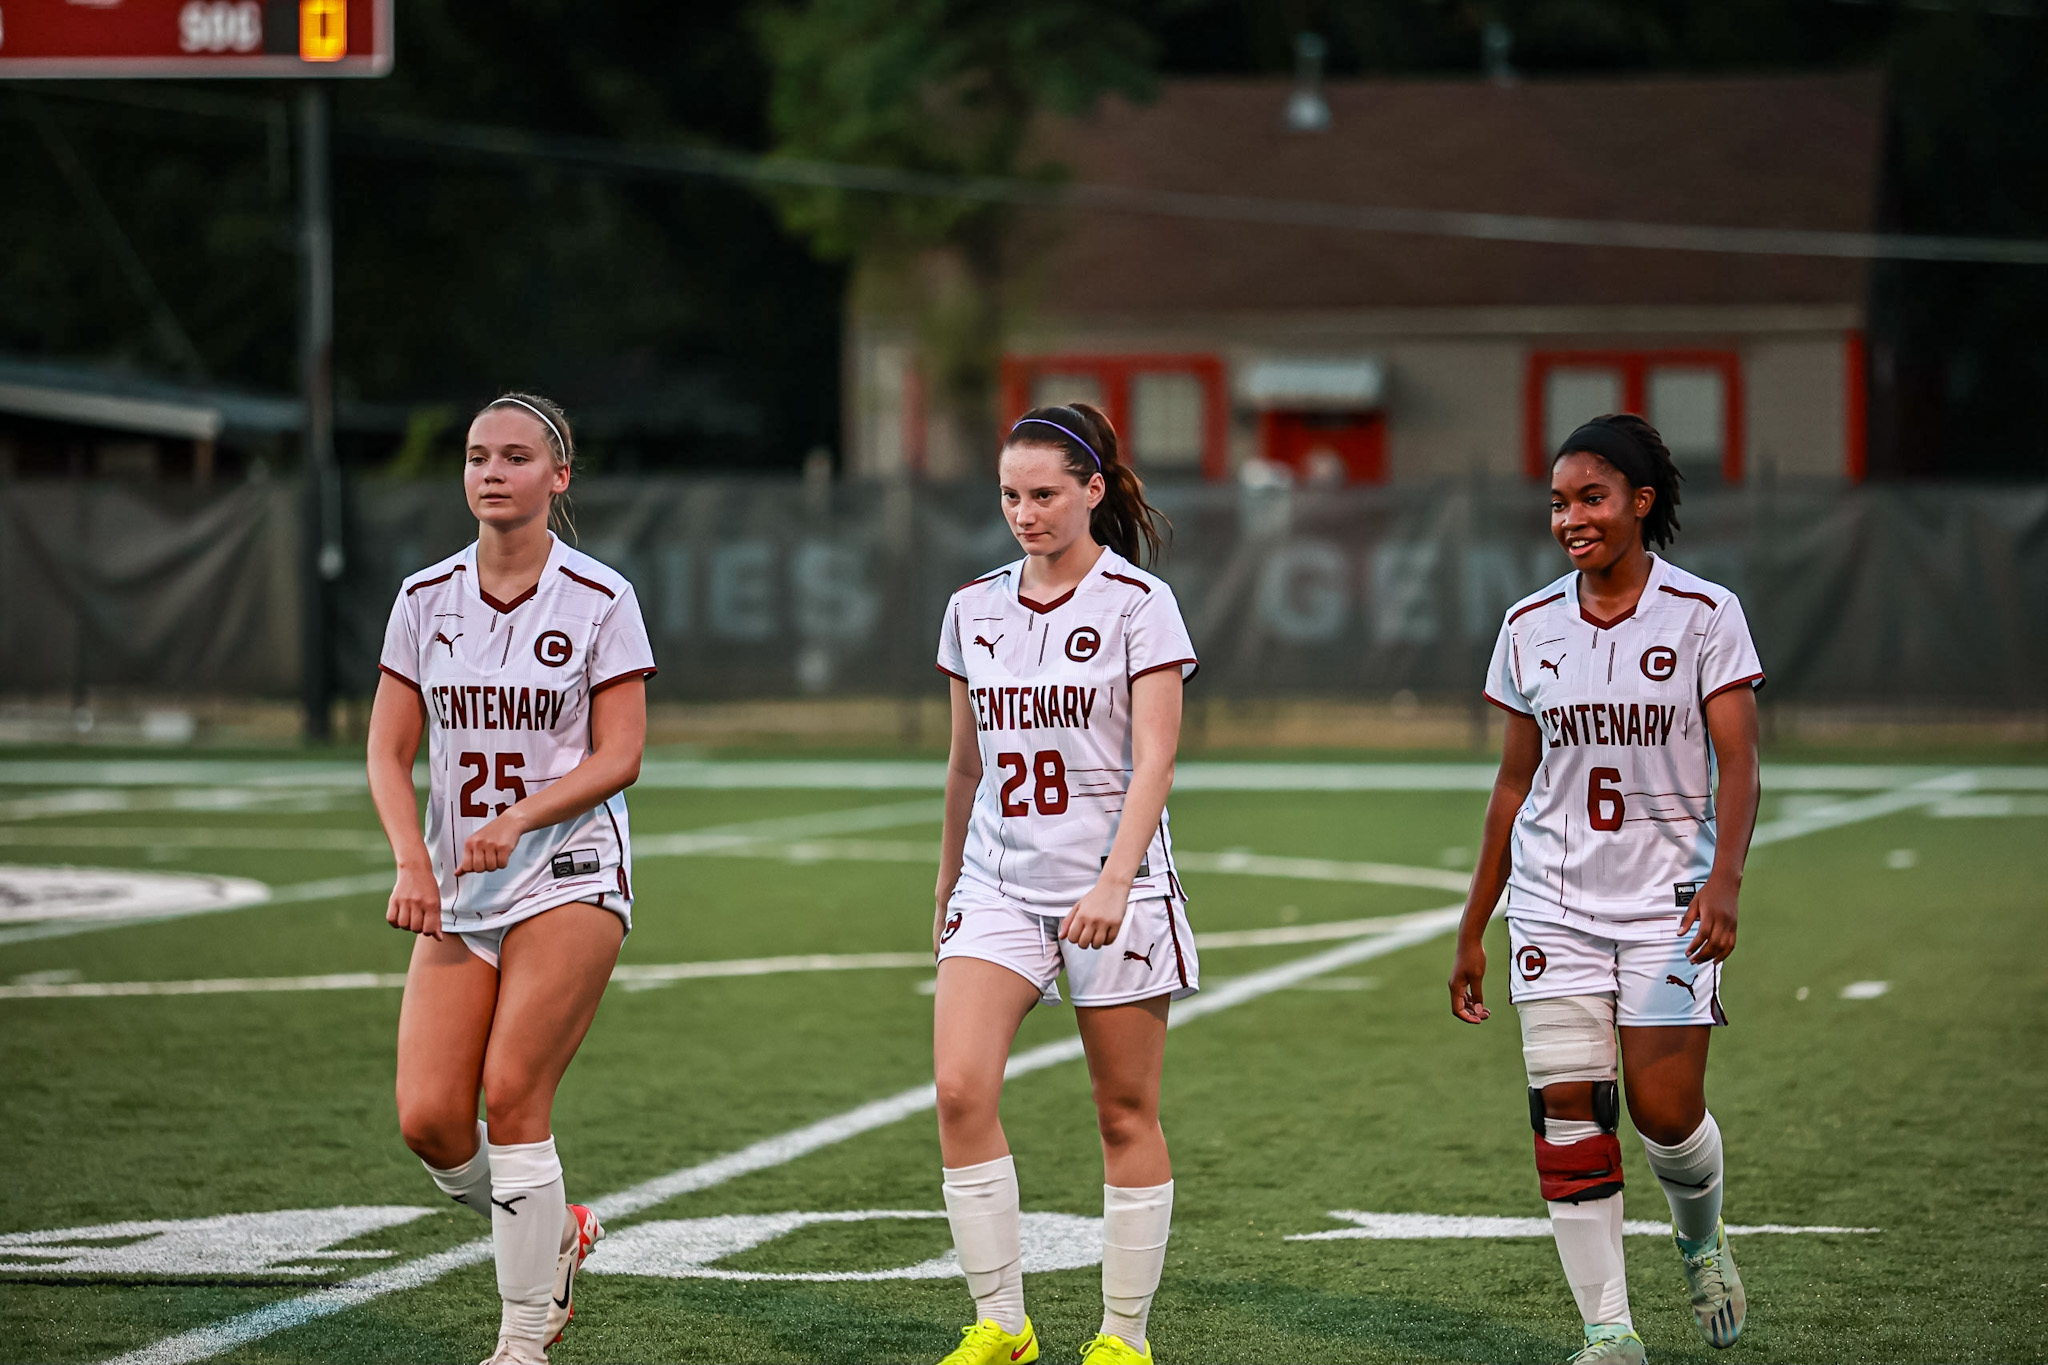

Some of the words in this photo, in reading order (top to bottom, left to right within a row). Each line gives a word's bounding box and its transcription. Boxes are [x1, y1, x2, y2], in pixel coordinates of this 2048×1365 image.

[540, 635, 567, 663] C
[1069, 630, 1096, 658] C
[1646, 650, 1672, 677] C
[459, 751, 527, 818] 25
[997, 749, 1069, 818] 28
[1587, 766, 1626, 832] 6
